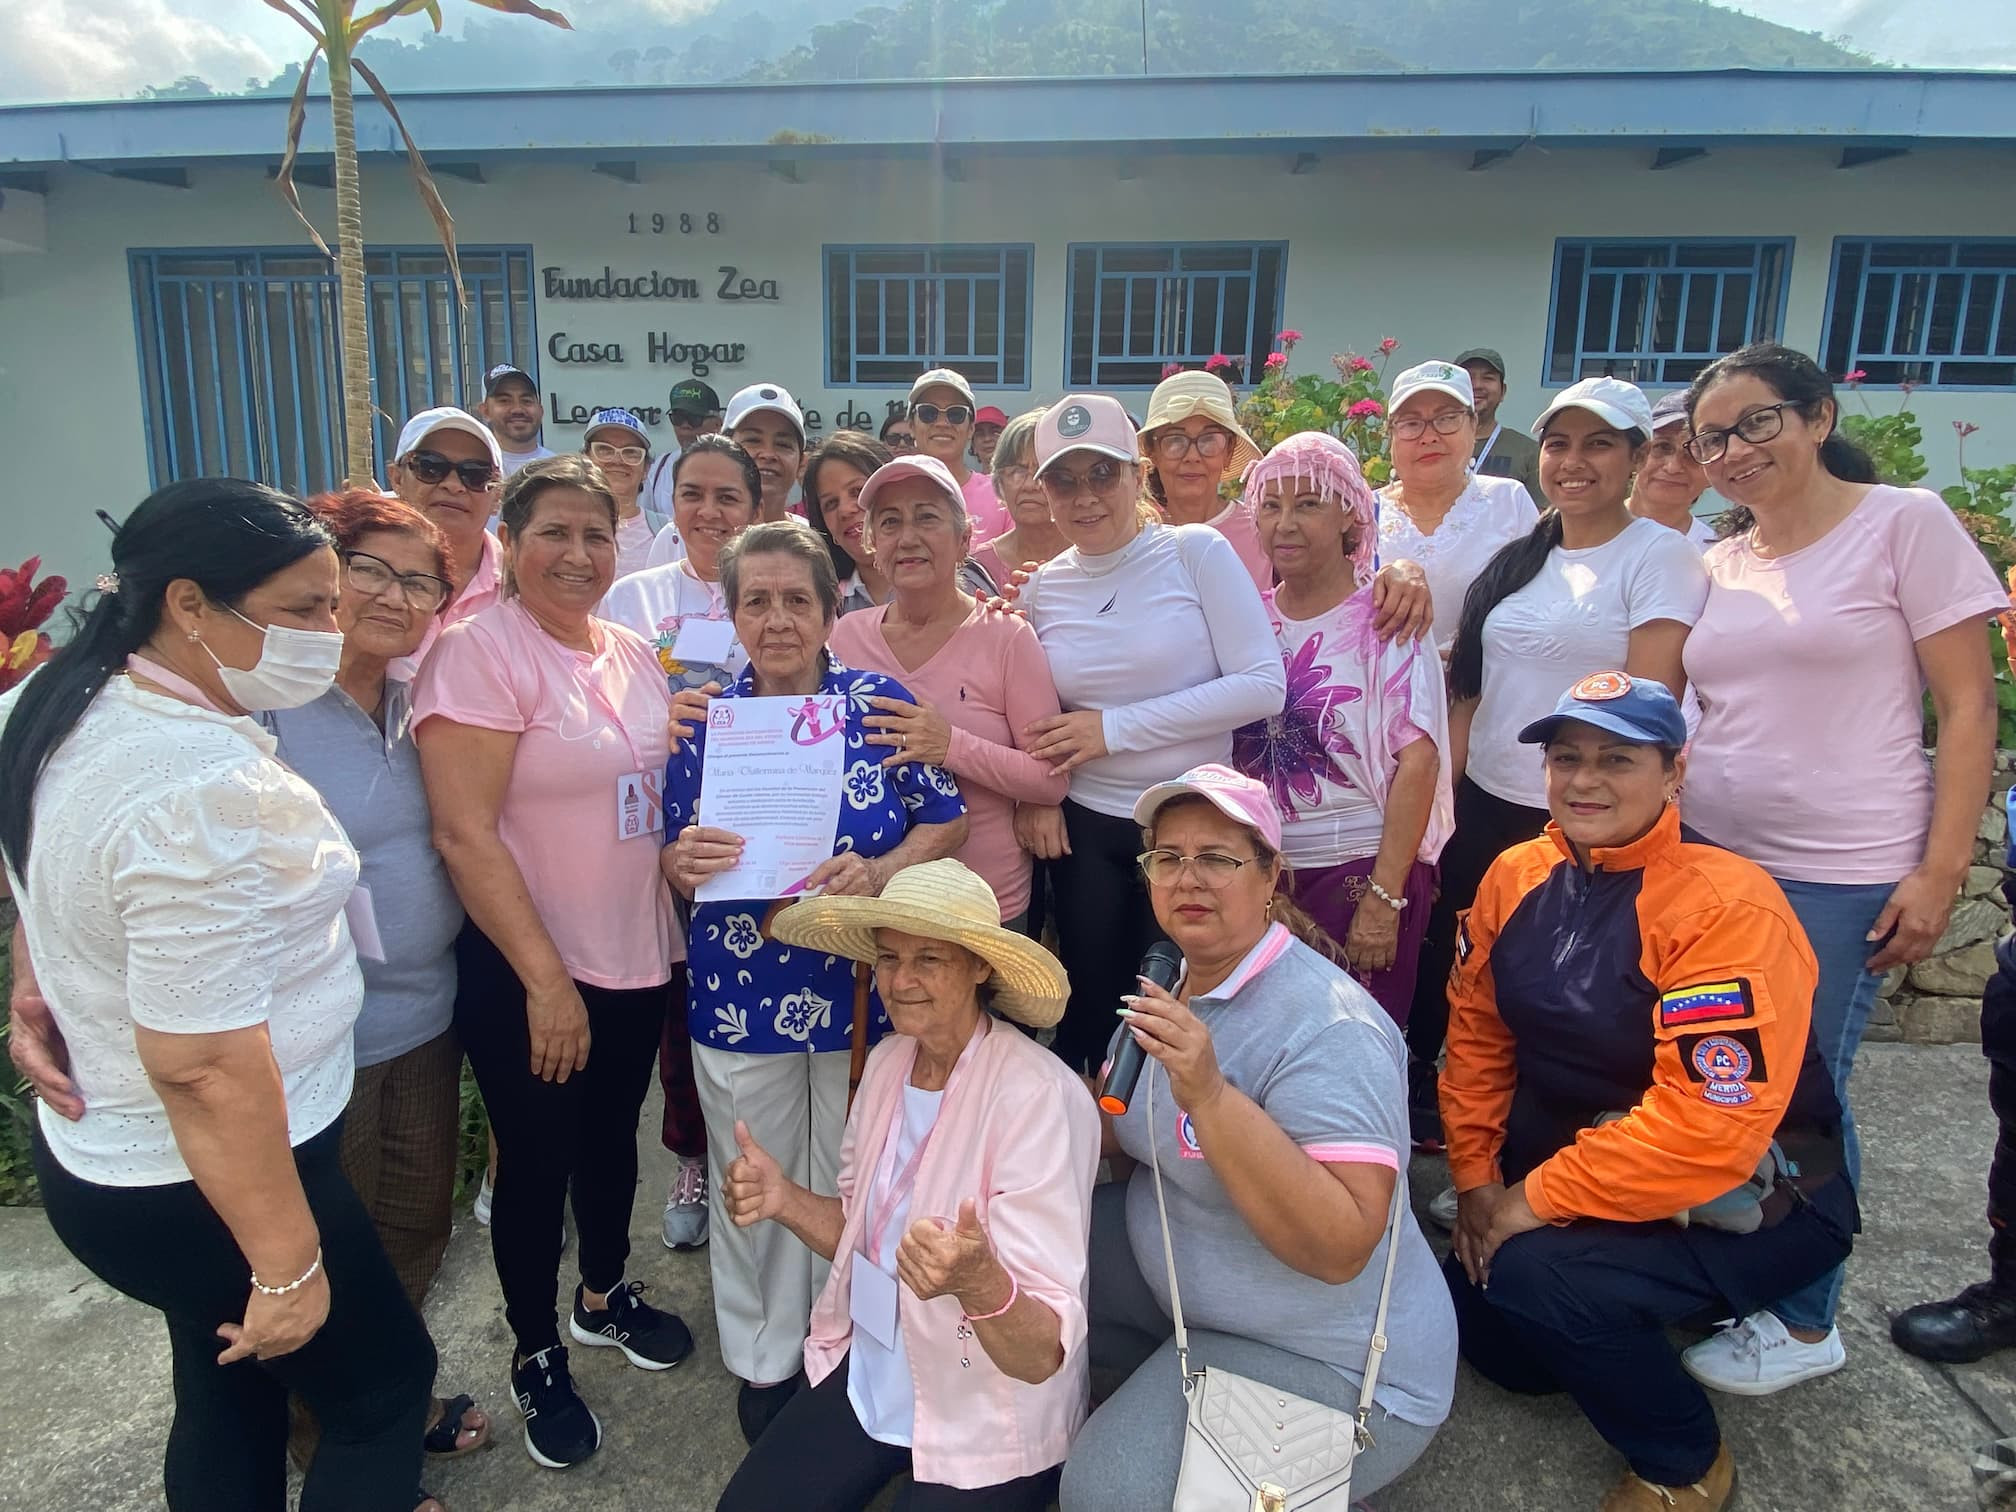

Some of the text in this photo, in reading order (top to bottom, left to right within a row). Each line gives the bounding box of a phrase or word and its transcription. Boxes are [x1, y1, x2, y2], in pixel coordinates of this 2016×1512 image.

[627, 212, 721, 234] 1988
[542, 265, 780, 300] Fundacion Zea
[547, 331, 746, 377] Casa Hogar
[550, 393, 662, 425] Leor
[835, 400, 873, 431] de
[1715, 1055, 1730, 1066] PC
[1709, 1081, 1746, 1094] MERIDA
